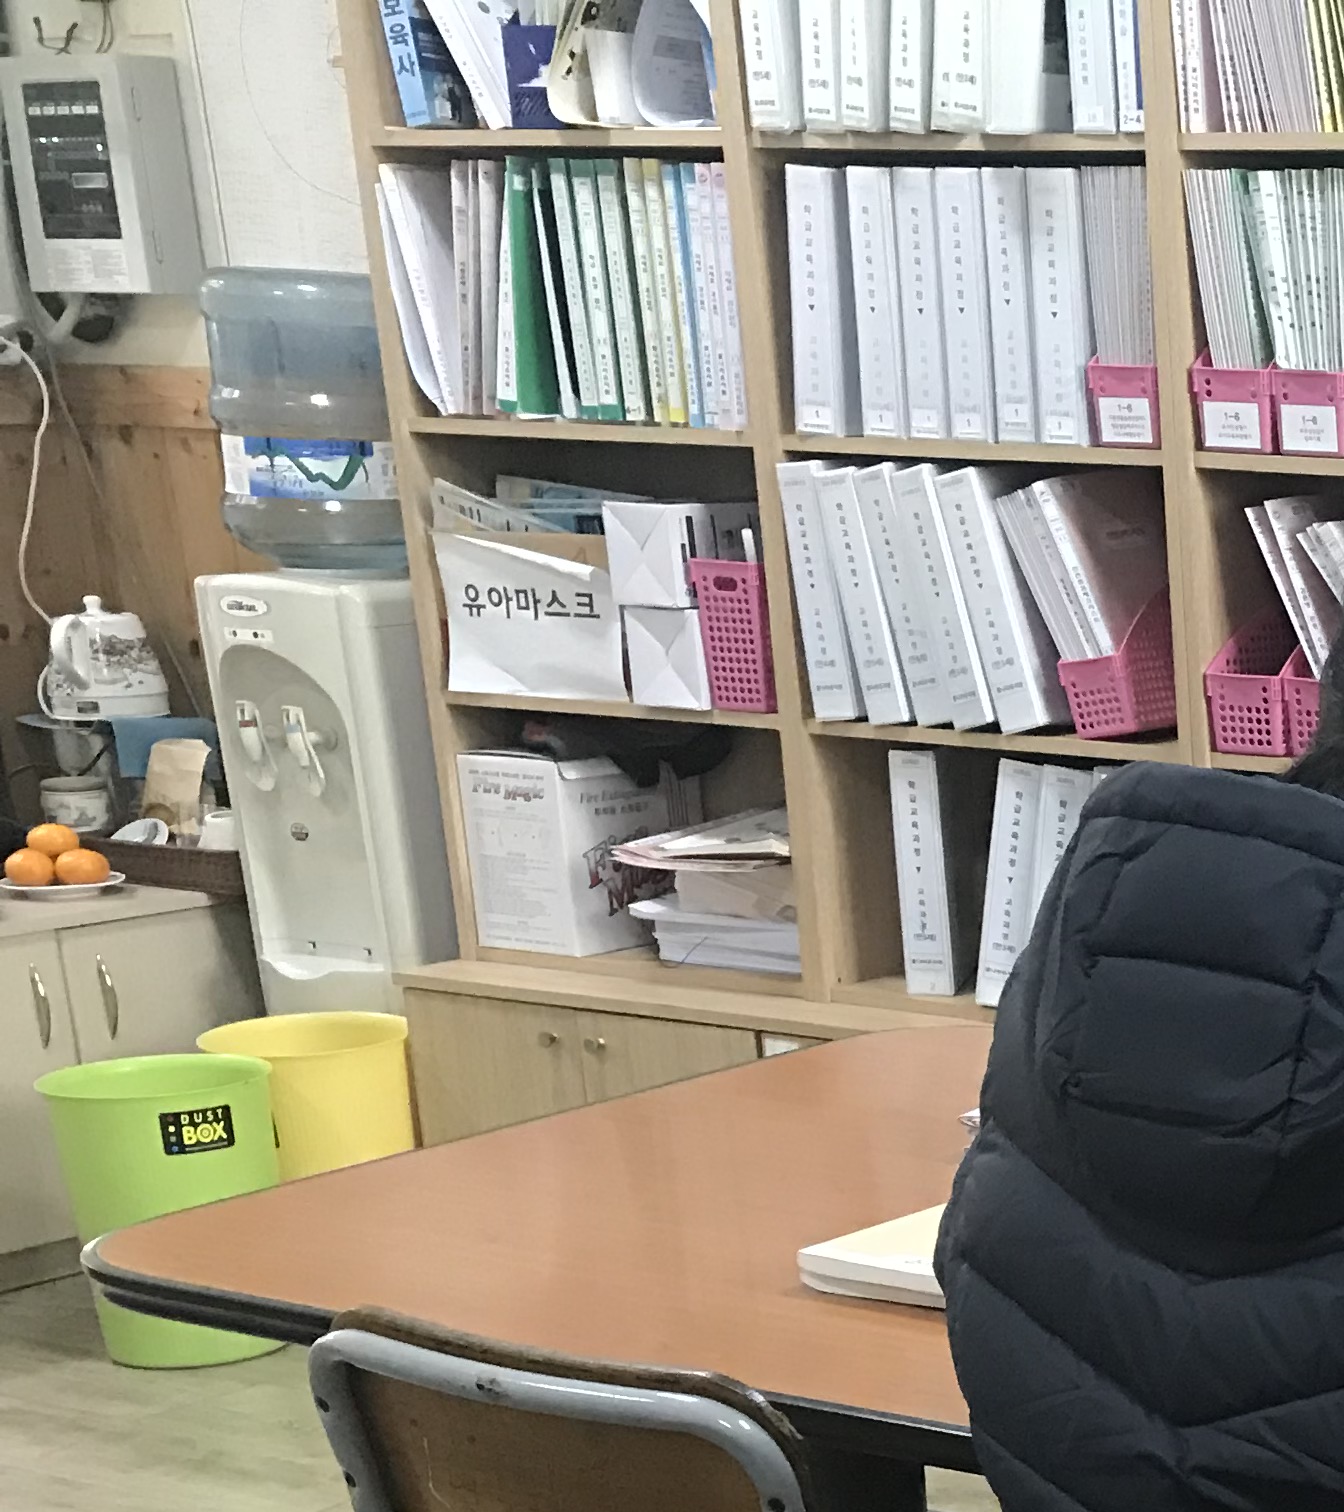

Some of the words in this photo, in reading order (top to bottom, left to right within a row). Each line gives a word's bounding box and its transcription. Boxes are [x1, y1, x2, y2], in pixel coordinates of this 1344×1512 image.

[463, 584, 600, 620] 유아마스크
[181, 1110, 225, 1125] DUST
[182, 1122, 227, 1146] BOX
